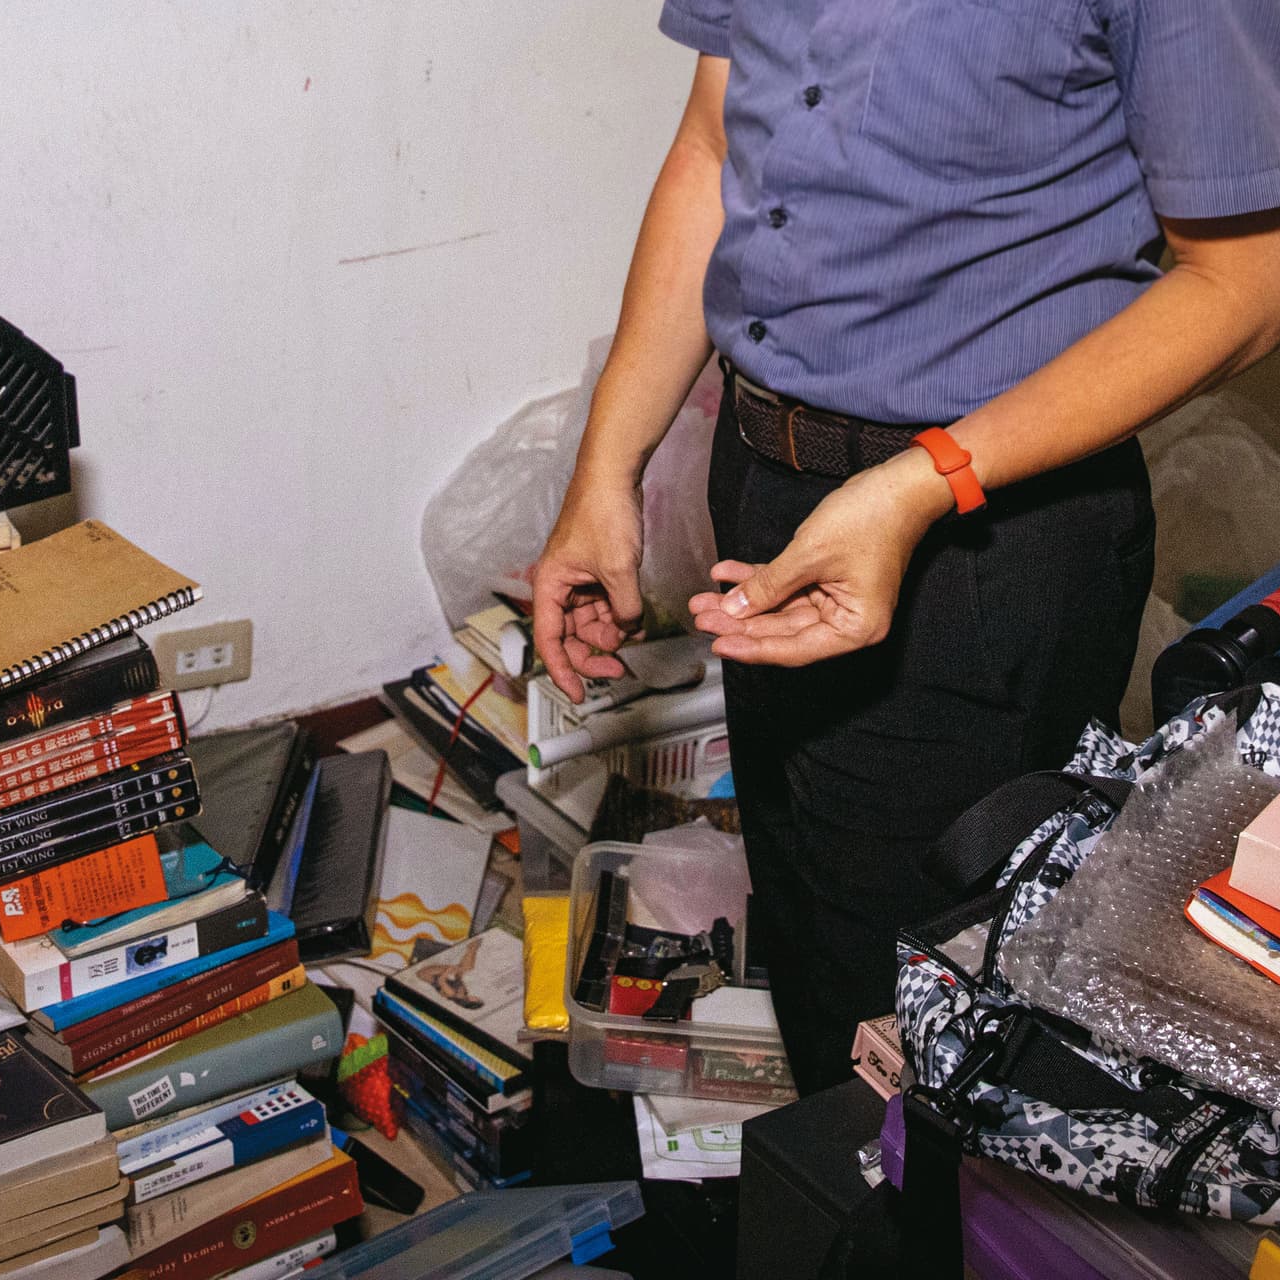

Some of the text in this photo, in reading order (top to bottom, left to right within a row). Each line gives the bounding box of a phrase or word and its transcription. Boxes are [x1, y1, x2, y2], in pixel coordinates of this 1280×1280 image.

[17, 811, 48, 831] WING
[21, 830, 52, 850] WING
[23, 848, 55, 868] WING
[82, 984, 234, 1063] SIGNS OF THE UNSEEN RUMI
[133, 1094, 147, 1107] THIS
[136, 1089, 171, 1116] DIFFERENT
[183, 1240, 224, 1263] Demon
